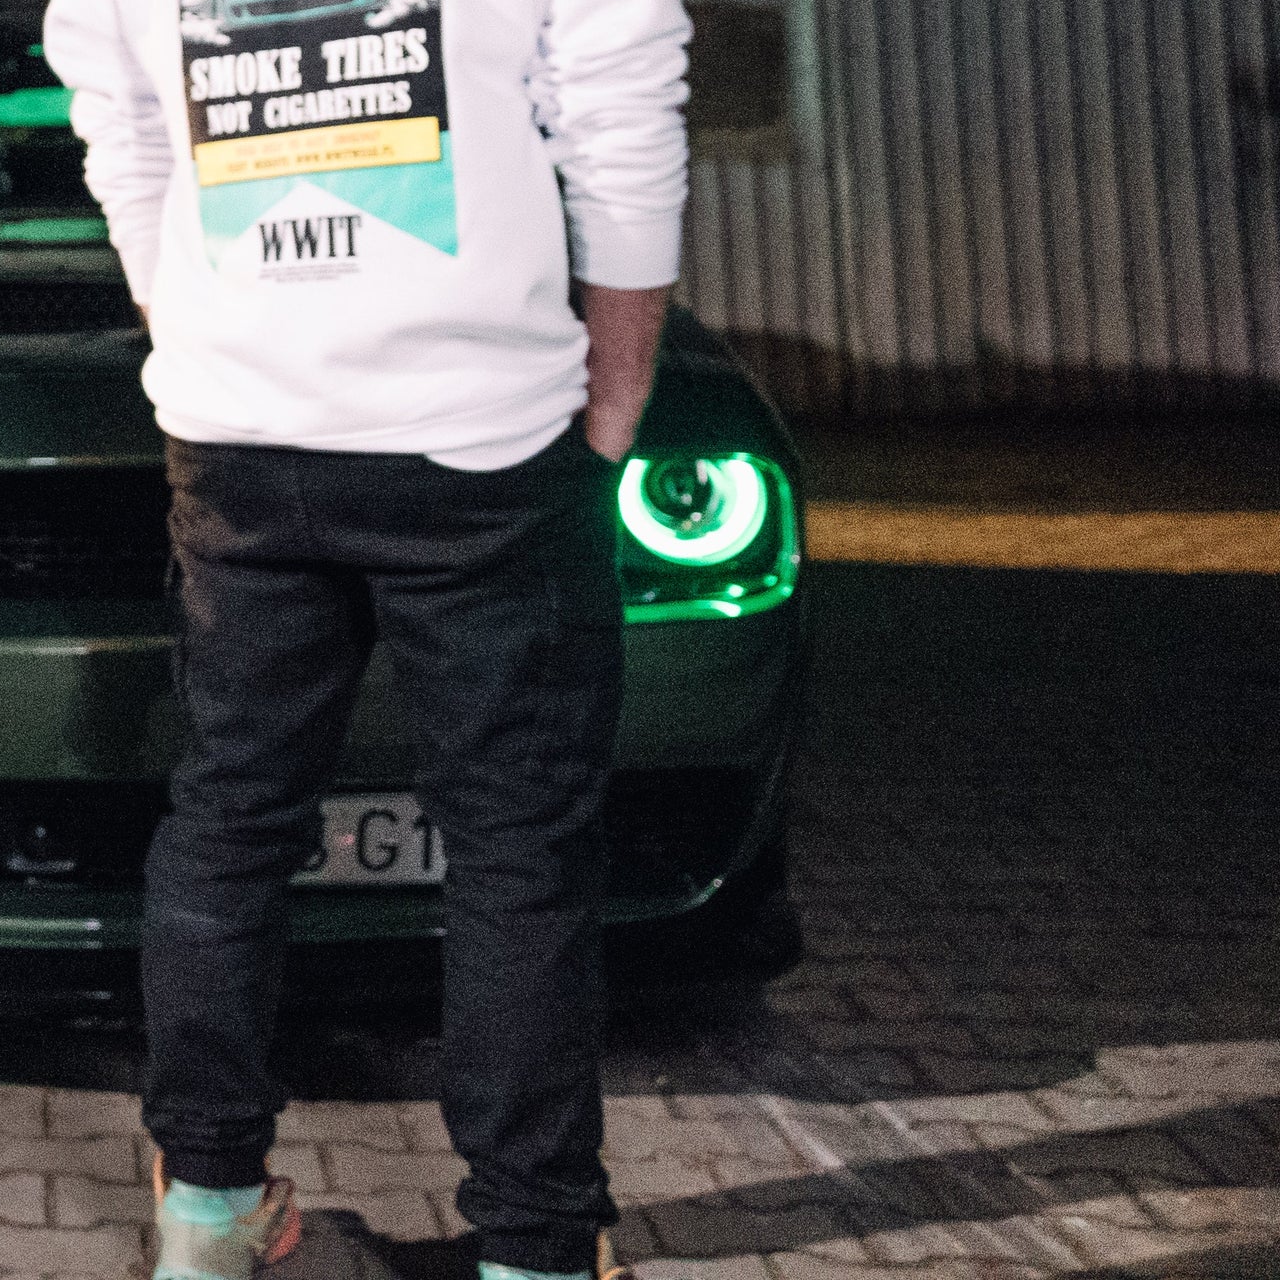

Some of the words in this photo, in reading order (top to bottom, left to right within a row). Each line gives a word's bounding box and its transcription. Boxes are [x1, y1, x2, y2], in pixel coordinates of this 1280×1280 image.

[191, 47, 302, 101] SMOKE
[322, 28, 430, 83] TIRES
[206, 101, 253, 136] NOT
[264, 81, 412, 129] CIGARETTES
[258, 214, 362, 262] WWIT
